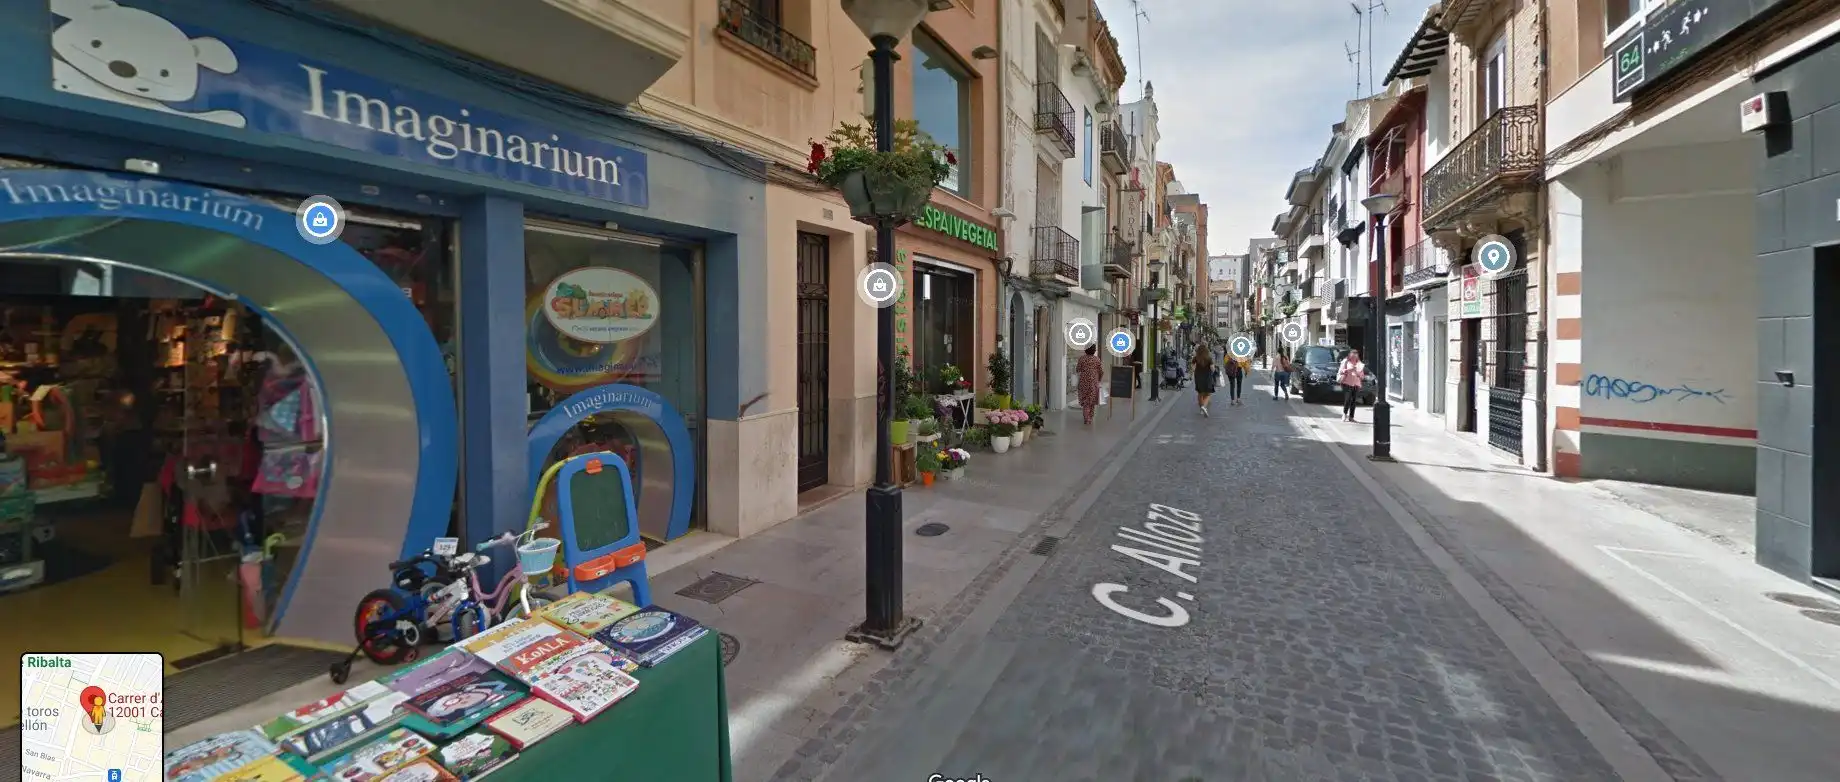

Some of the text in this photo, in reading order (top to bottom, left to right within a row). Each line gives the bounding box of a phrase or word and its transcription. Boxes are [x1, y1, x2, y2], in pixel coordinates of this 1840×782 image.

[1620, 44, 1641, 73] 64
[298, 62, 621, 186] Imaginarium
[1, 177, 264, 231] Imaginarium
[563, 388, 653, 419] Imaginarium
